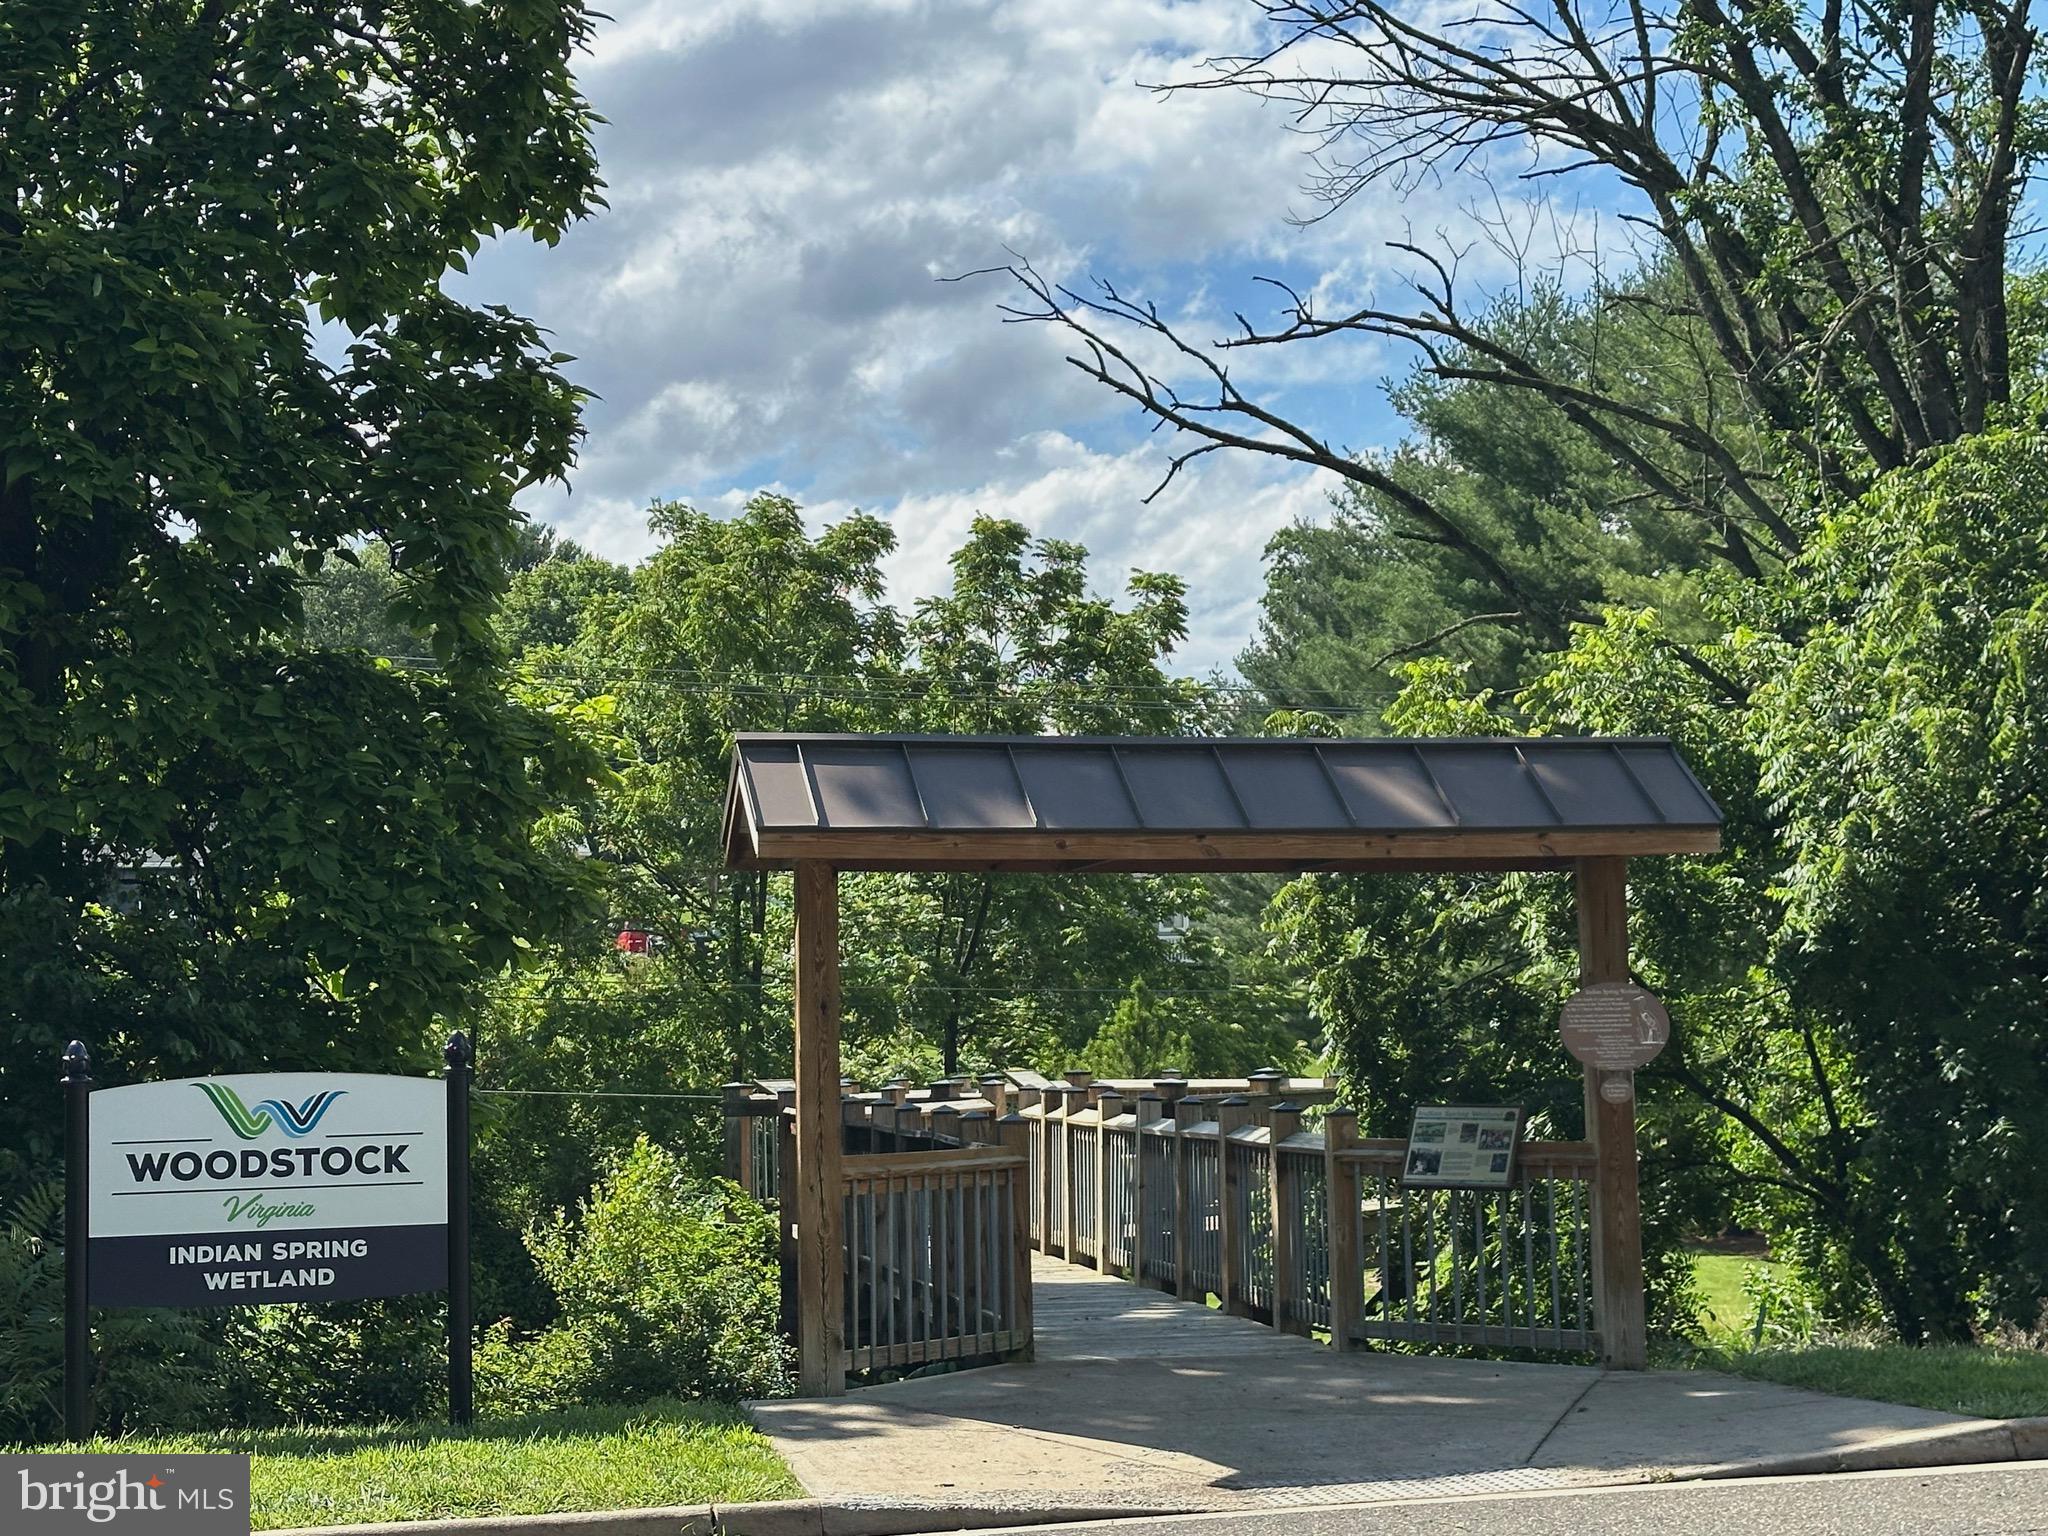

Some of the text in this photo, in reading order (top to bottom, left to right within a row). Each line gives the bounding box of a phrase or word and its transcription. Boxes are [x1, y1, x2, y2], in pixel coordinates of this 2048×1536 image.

[125, 1144, 410, 1182] WOODSTOCK
[222, 1193, 316, 1228] Virginia
[169, 1239, 368, 1265] INDIAN SPRING
[203, 1268, 336, 1291] WETLAND
